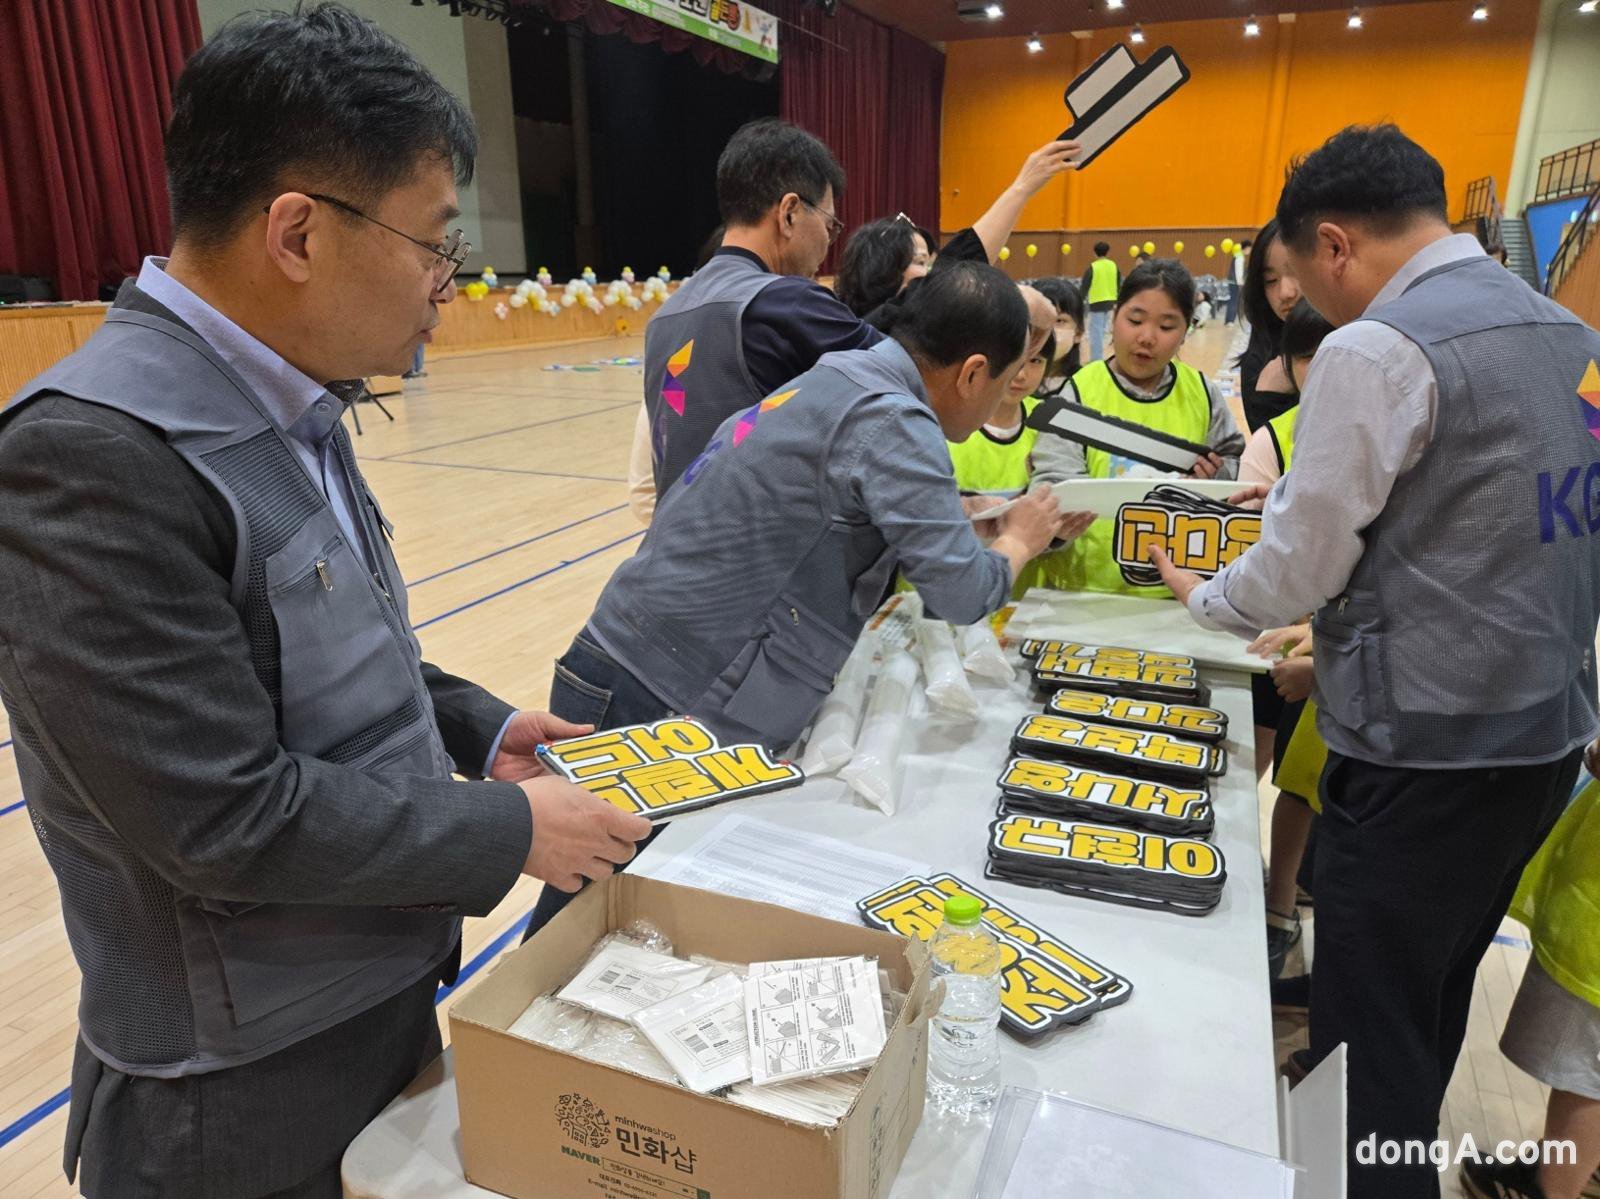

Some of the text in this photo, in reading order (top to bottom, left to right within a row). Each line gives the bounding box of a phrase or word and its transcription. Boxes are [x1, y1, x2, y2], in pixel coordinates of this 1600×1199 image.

[1023, 716, 1203, 767] 박보경
[1007, 760, 1201, 817] 서나영
[1000, 817, 1215, 877] 이현규
[614, 1115, 677, 1141] minhwashop
[616, 1127, 698, 1176] 민화샵
[560, 1145, 601, 1166] NAVER
